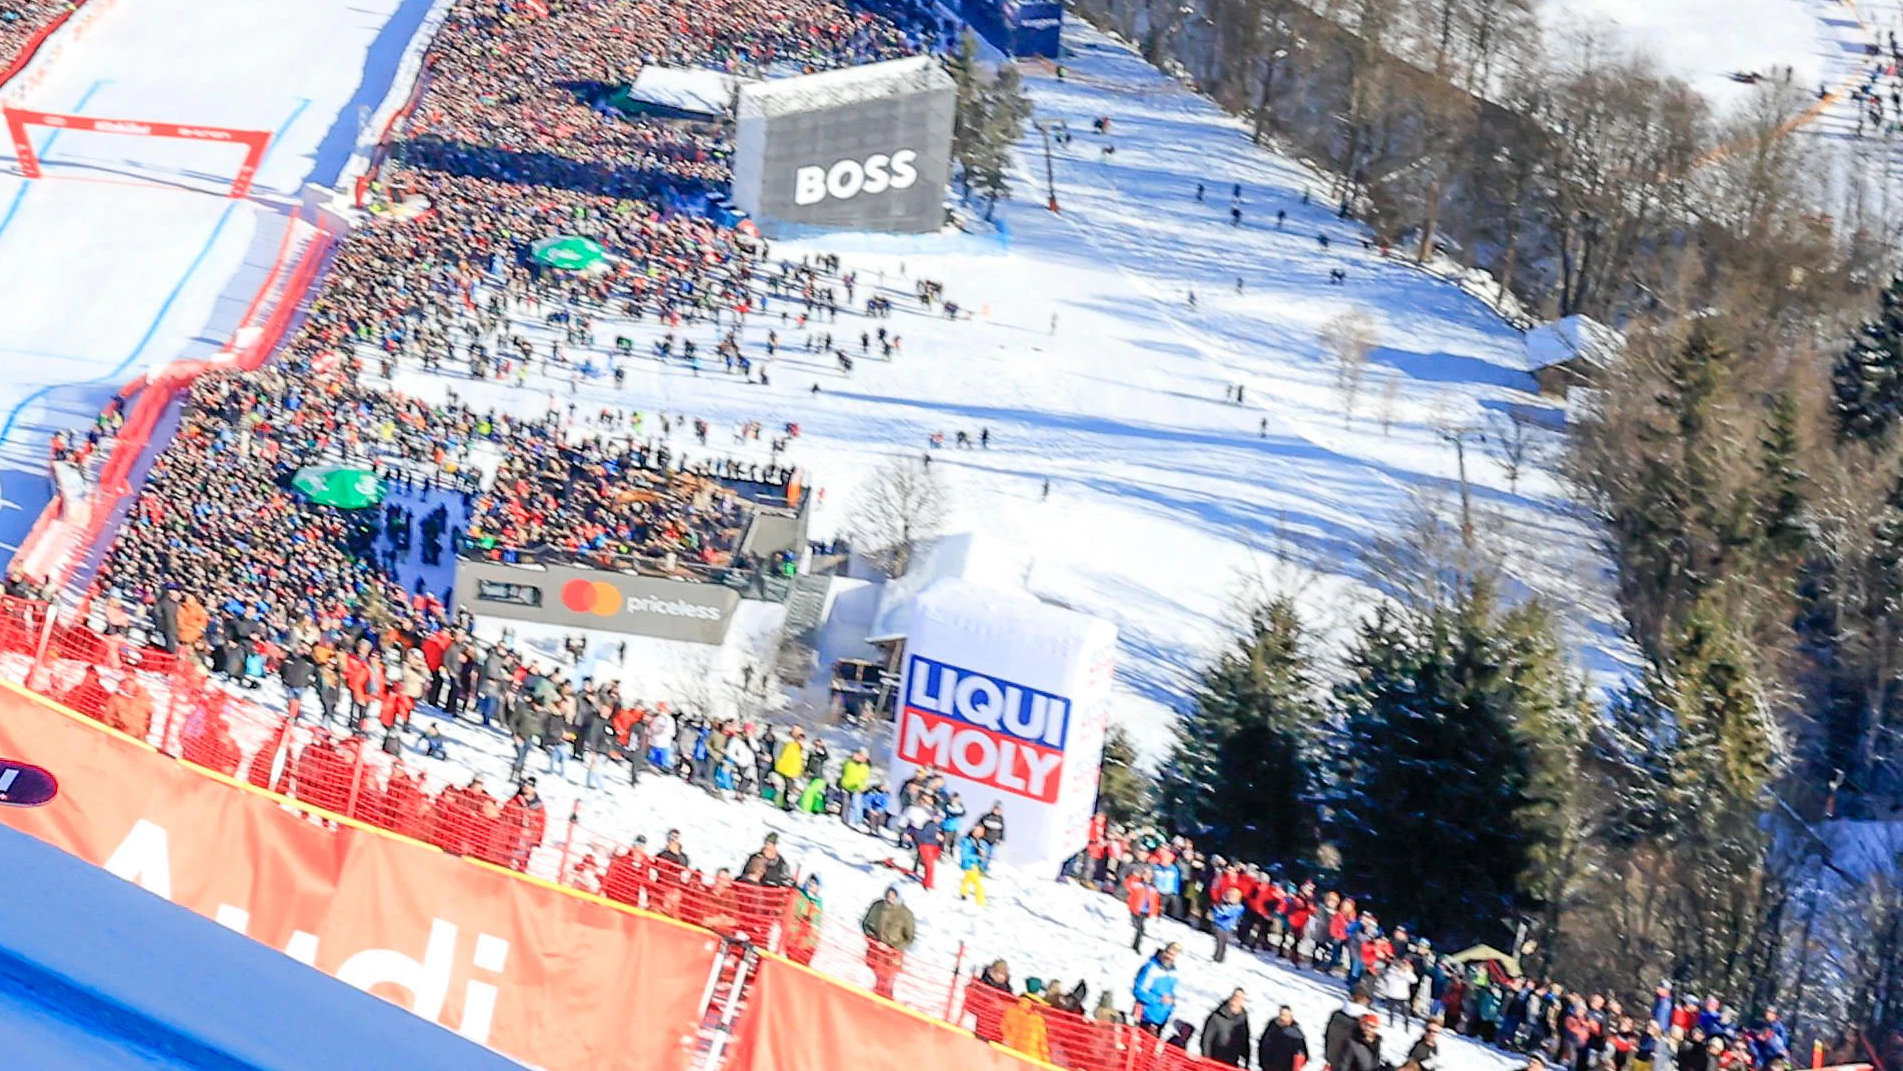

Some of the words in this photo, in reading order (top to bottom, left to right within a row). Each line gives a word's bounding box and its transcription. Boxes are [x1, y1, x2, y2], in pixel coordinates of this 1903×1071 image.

[795, 149, 918, 206] BOSS
[626, 595, 722, 622] priceless
[910, 659, 1068, 748] LIQUI
[903, 713, 1064, 797] MOLY
